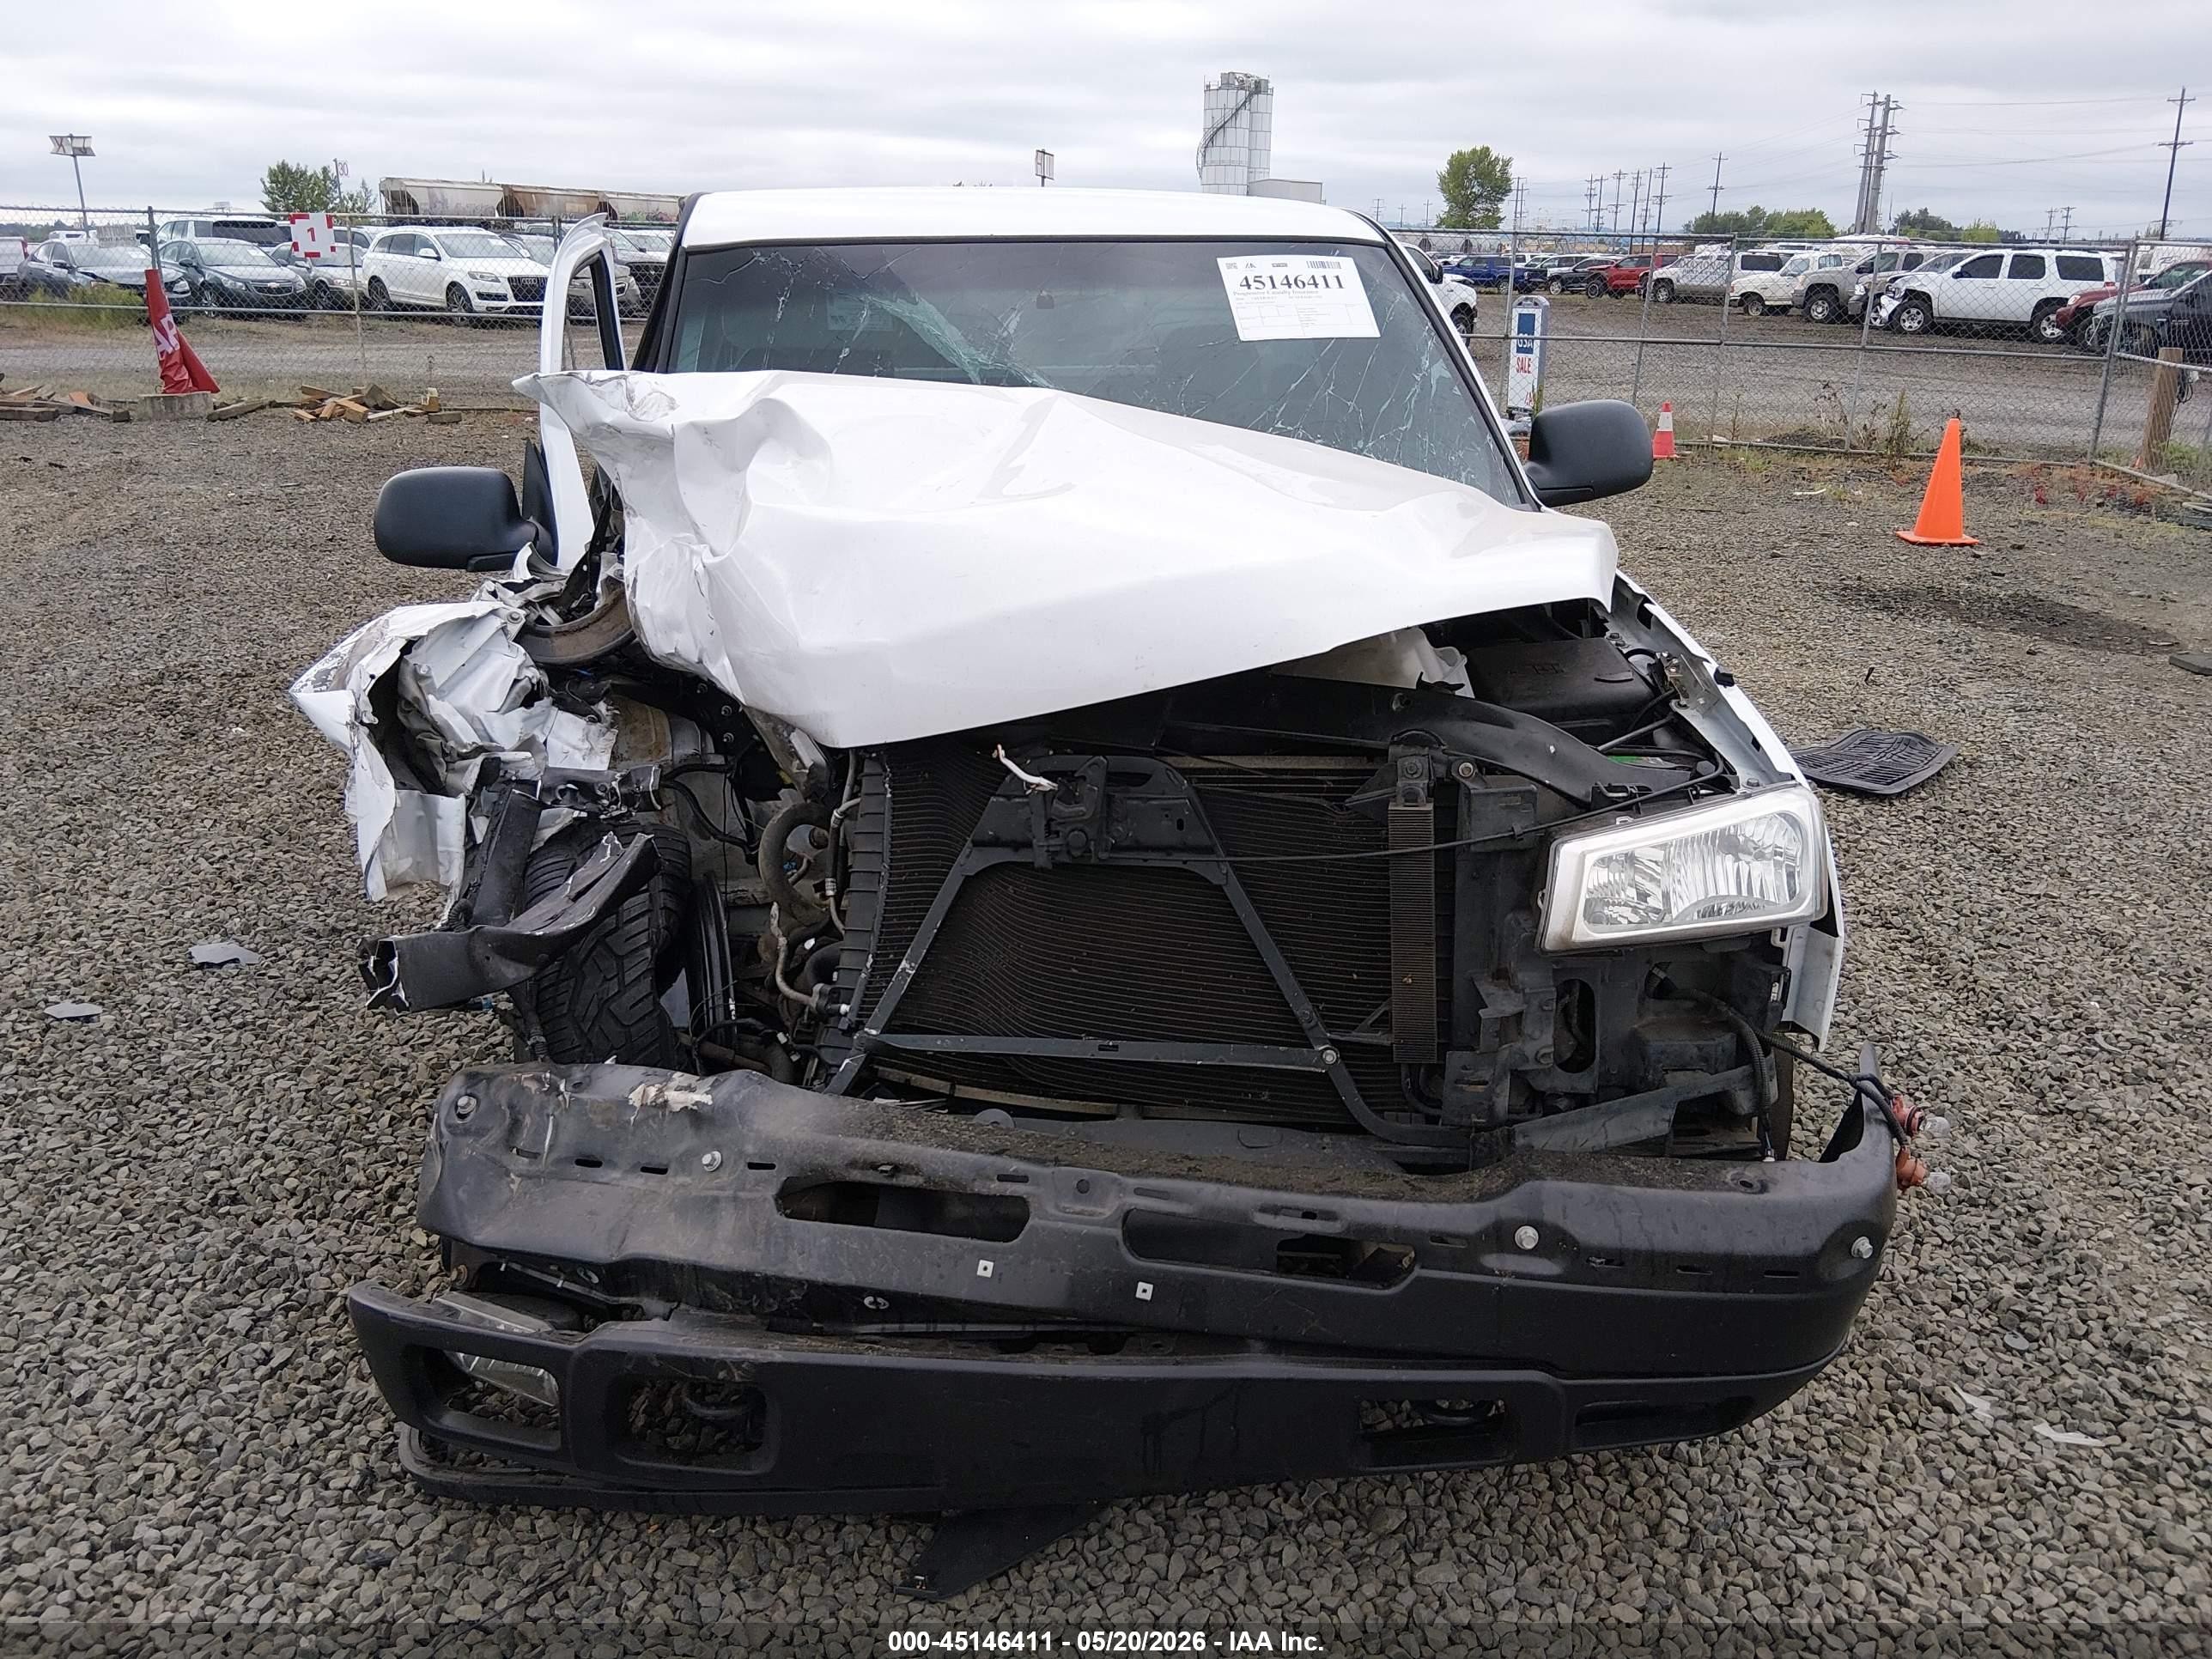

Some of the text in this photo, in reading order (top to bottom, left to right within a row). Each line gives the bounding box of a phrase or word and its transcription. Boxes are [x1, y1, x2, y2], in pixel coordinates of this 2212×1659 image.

[338, 162, 349, 176] 30
[307, 227, 316, 242] 1
[1239, 275, 1345, 290] 45146411
[1516, 356, 1532, 374] SALE
